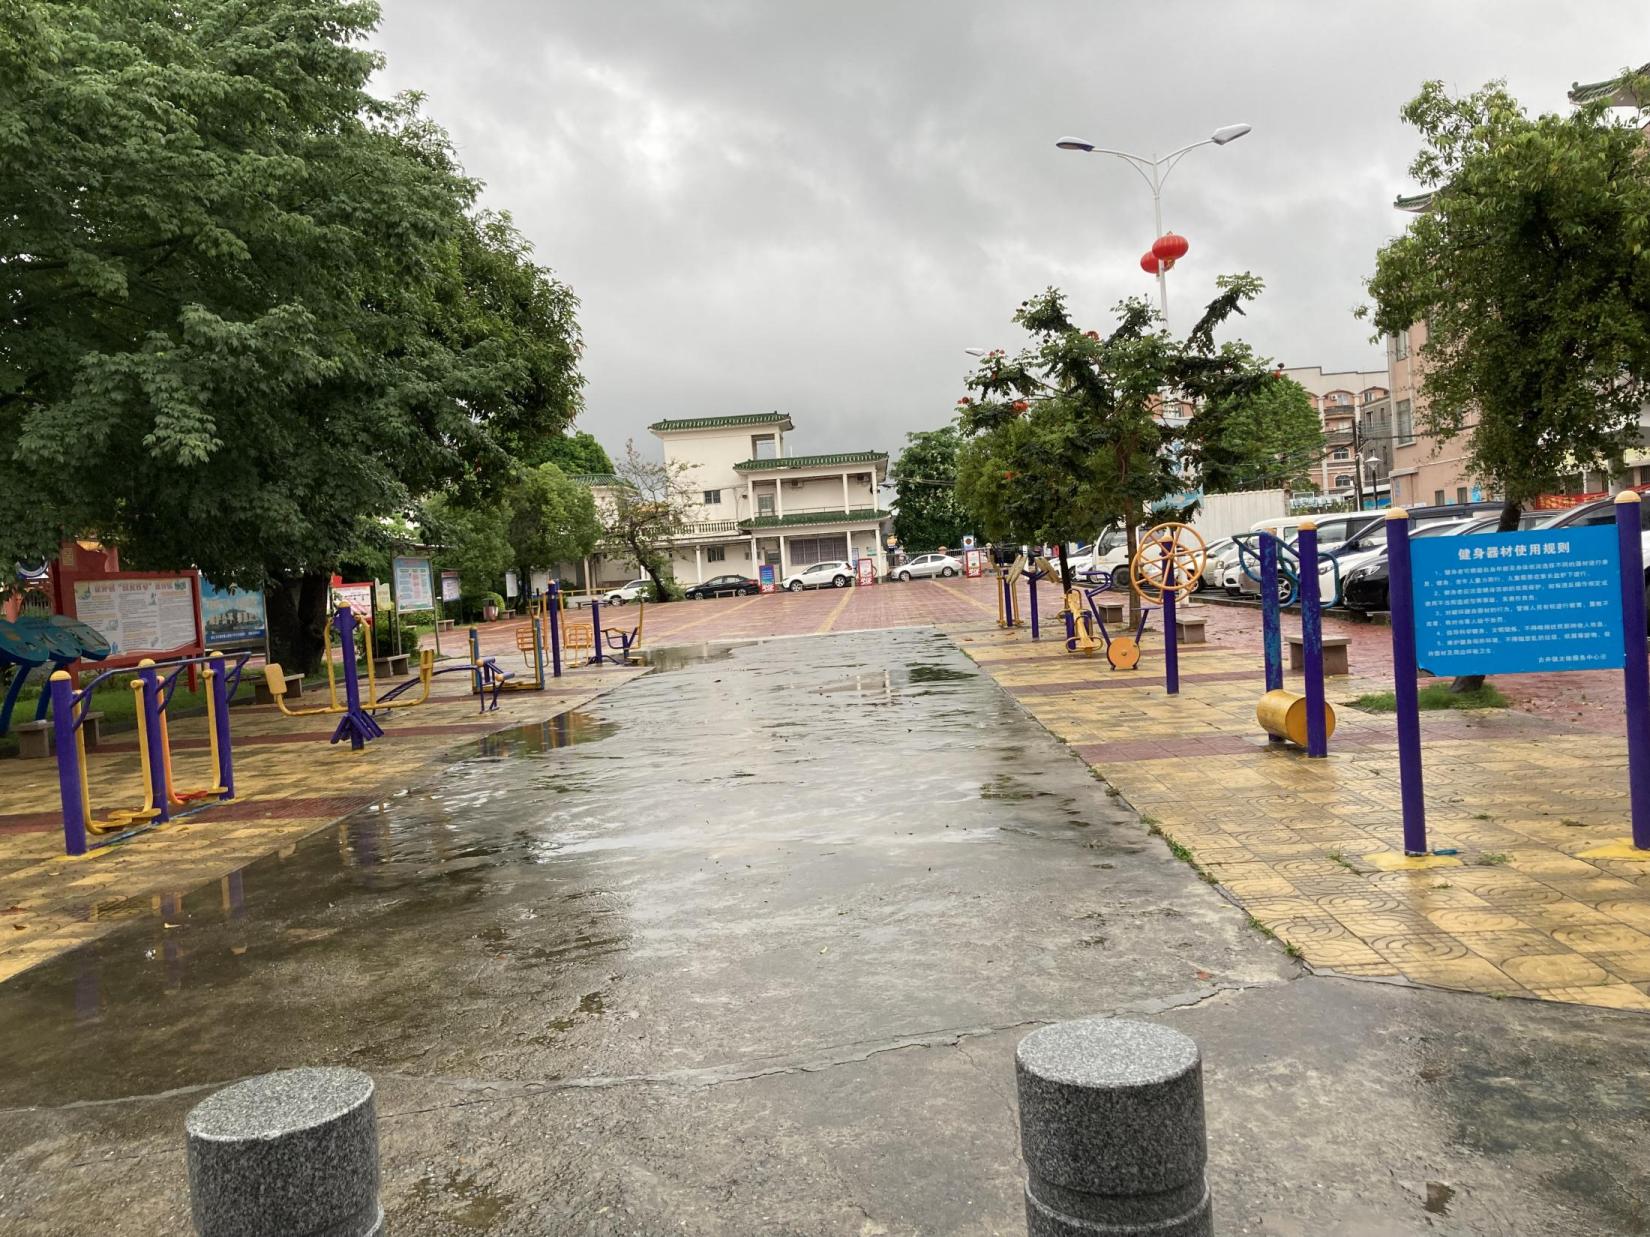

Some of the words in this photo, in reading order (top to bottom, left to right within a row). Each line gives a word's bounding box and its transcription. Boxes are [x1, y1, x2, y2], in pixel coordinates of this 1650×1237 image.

[1458, 541, 1570, 560] 健身器材使用规则
